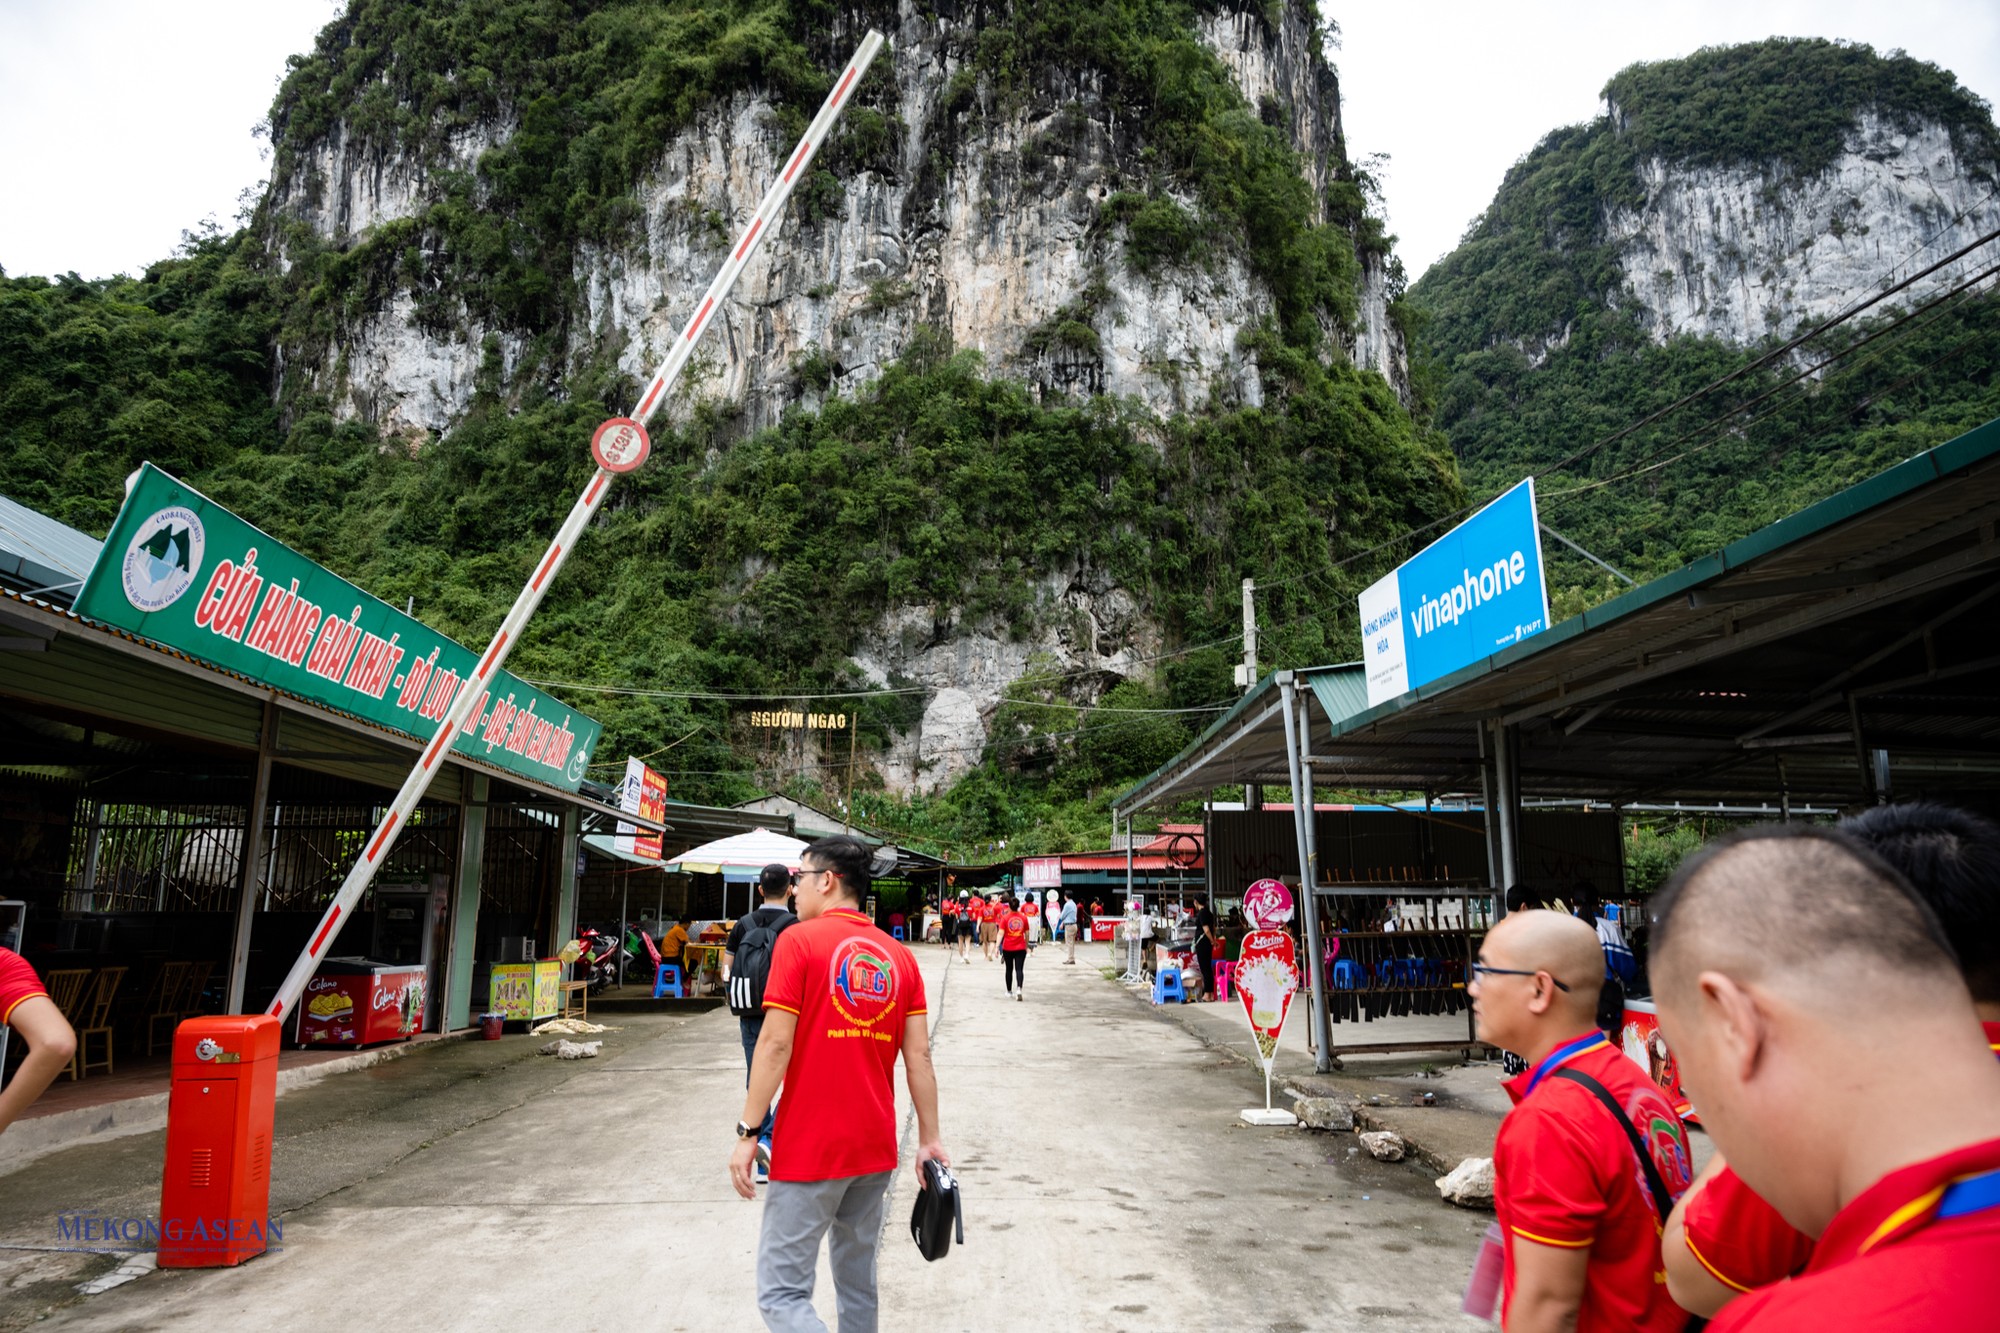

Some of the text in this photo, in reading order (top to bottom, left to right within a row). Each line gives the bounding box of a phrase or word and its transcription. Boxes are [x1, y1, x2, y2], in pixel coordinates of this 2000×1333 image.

[606, 427, 633, 462] STOP
[1411, 550, 1525, 638] vinaphone
[1379, 605, 1399, 629] KHÁNH
[1522, 619, 1541, 635] VNPT
[194, 547, 264, 643] CỬA
[244, 577, 322, 668] HÀNG
[306, 604, 363, 684] GIẢI
[343, 632, 405, 700] KHÁT
[396, 646, 440, 712] ĐỒ
[482, 693, 516, 753] ĐẶC
[505, 698, 538, 755] SẢN
[525, 717, 551, 763] CAO
[541, 714, 575, 770] BẰNG
[751, 708, 846, 729] NGƯỜM NGAO
[1050, 864, 1059, 880] XE
[1252, 934, 1285, 948] Merino
[308, 977, 338, 992] Celano
[852, 966, 884, 993] VCTC
[373, 986, 396, 1010] Celano
